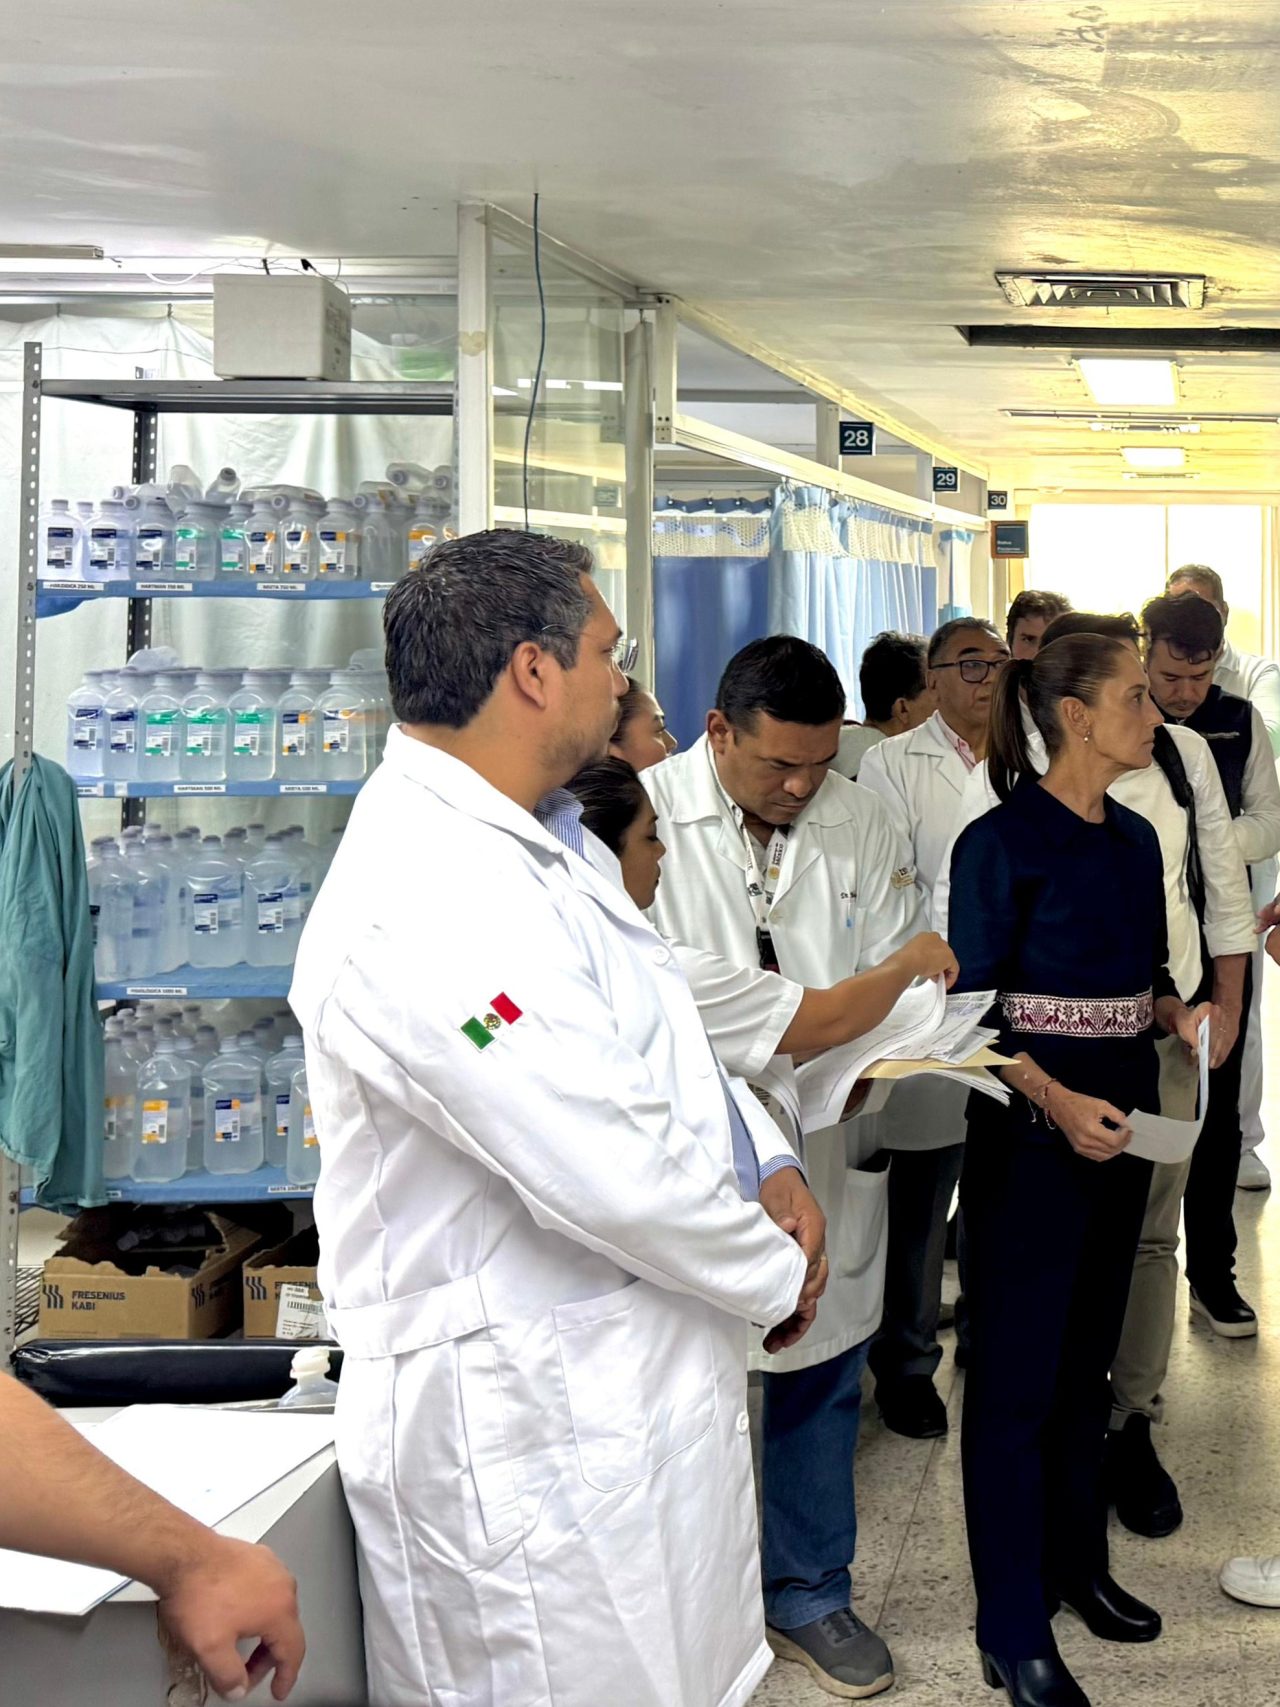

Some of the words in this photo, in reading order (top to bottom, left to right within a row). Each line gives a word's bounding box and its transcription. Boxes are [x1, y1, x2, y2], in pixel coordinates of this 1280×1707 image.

[844, 430, 869, 447] 28
[937, 473, 955, 486] 29
[991, 495, 1006, 506] 30
[72, 1290, 126, 1300] FRESENIUS
[71, 1301, 96, 1311] KABI
